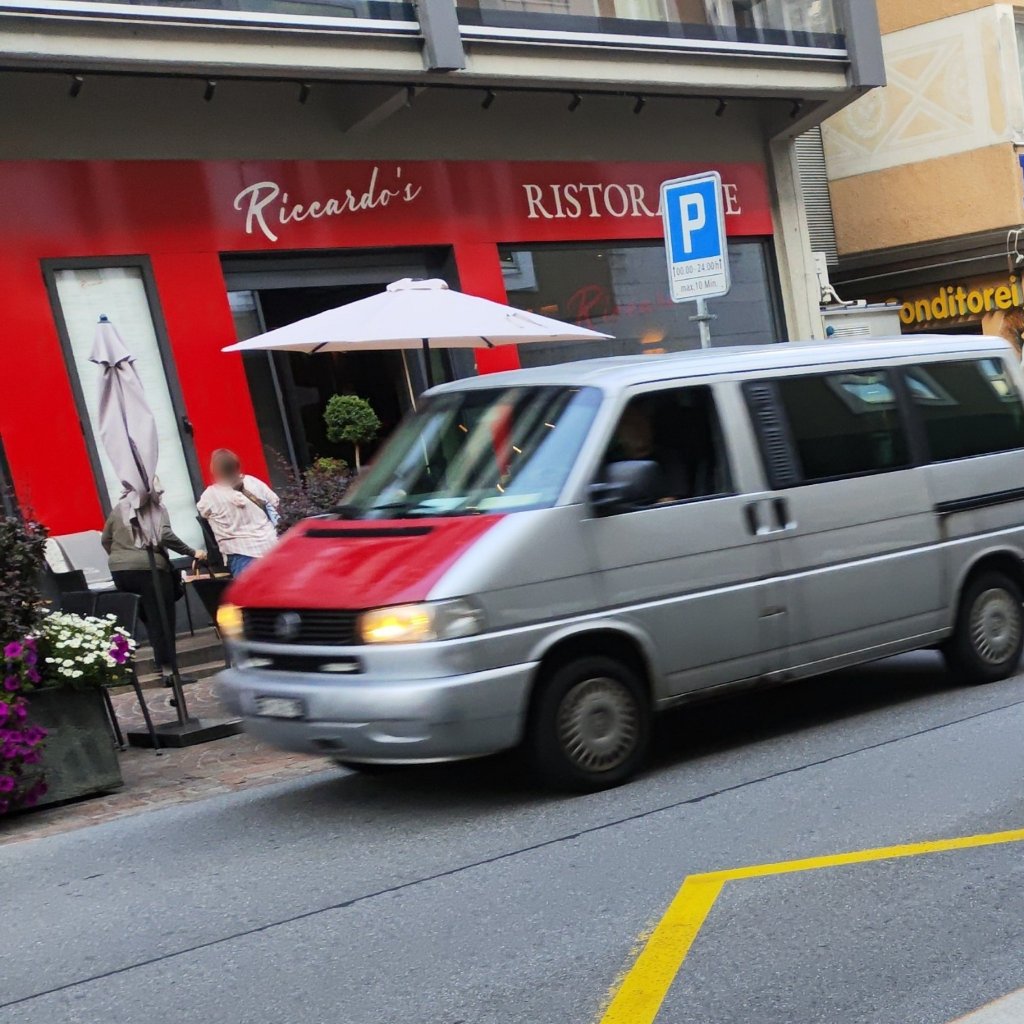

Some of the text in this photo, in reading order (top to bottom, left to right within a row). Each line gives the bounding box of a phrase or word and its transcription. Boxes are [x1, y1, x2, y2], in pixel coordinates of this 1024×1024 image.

[234, 166, 422, 242] Riccardo's
[525, 183, 742, 219] RISTORE
[679, 192, 706, 254] P
[896, 275, 1019, 325] onditorei
